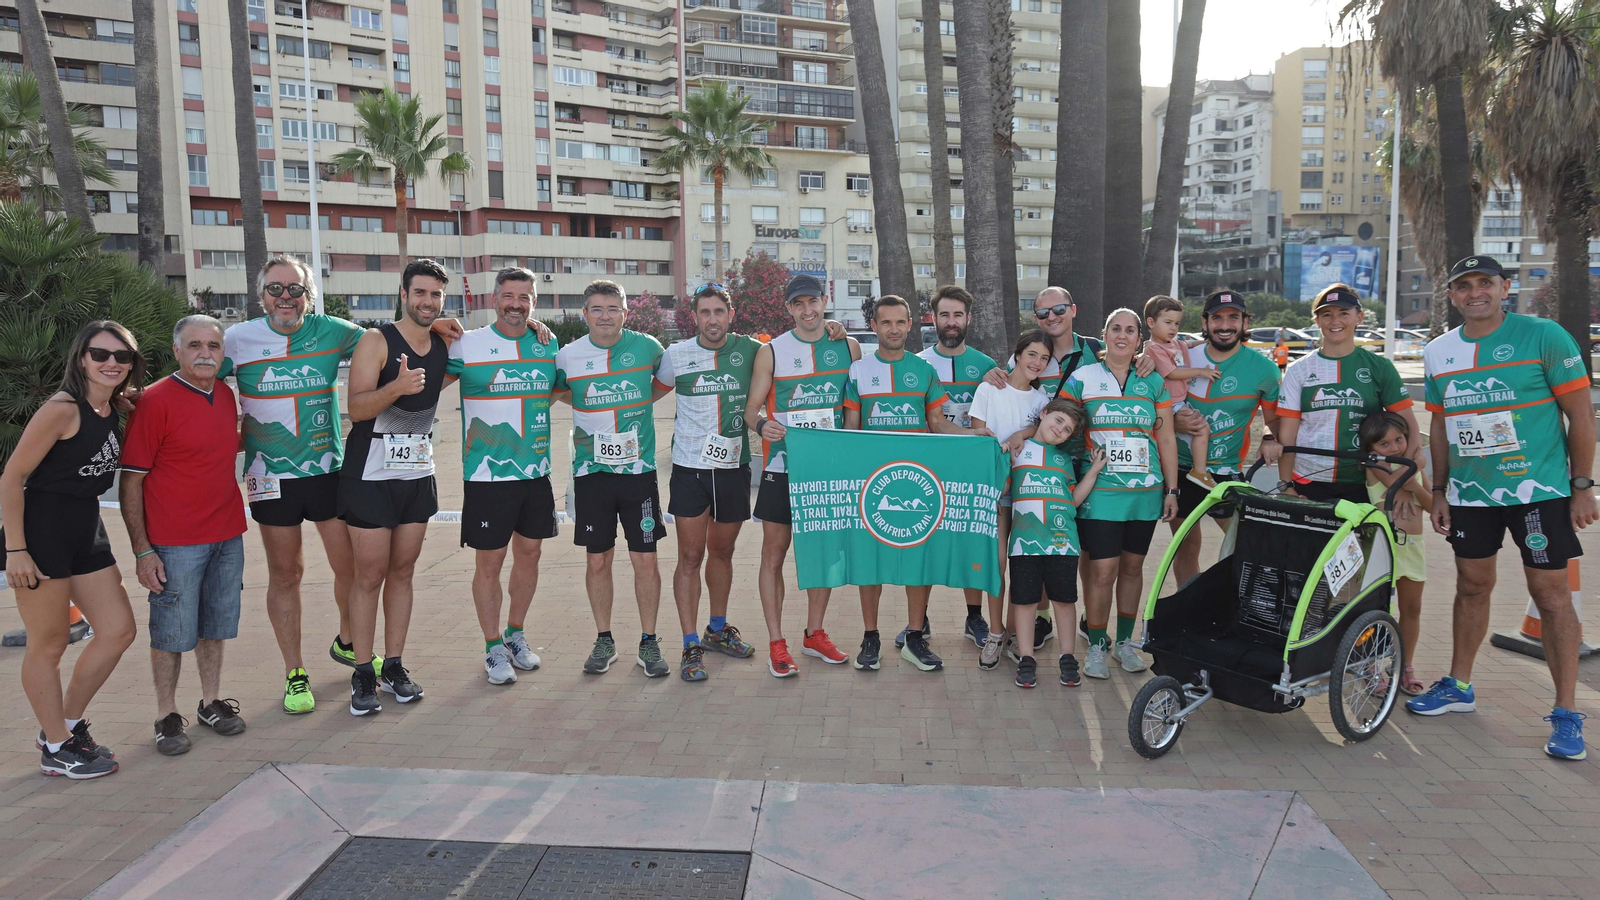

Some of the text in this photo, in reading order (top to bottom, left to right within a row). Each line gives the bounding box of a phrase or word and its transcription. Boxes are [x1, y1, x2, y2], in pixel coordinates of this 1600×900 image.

[755, 225, 821, 239] EuropaSur
[258, 376, 328, 392] EURAFRICA TRAIL
[490, 381, 550, 393] EURAFRICA TRAIL
[693, 382, 740, 394] EURAFRICA TRAIL
[305, 396, 332, 406] dinan
[584, 390, 642, 406] EURAFRICA TRAIL
[1311, 398, 1364, 409] EURAFRICA TRAIL
[1443, 390, 1517, 409] EURAFRICA TRAIL
[623, 408, 646, 418] dinan
[904, 416, 920, 425] TRAIL
[1092, 415, 1152, 426] EURAFRICA TRAIL
[1214, 418, 1235, 432] TRAIL
[1459, 430, 1484, 445] 624
[390, 446, 411, 460] 143
[600, 443, 622, 456] 863
[706, 444, 728, 460] 359
[1110, 450, 1132, 462] 546
[872, 469, 934, 496] CLUB DEPORTIVO
[1019, 486, 1065, 496] EURAFRICA TRAIL
[801, 492, 852, 507] EURAFRICA
[945, 494, 969, 507] TRAIL
[802, 507, 829, 519] TRAIL
[831, 505, 859, 518] TRAIL
[973, 509, 998, 526] TRAIL
[803, 518, 852, 533] EURAFRICA
[871, 511, 933, 538] EURAFRICA TRAIL
[1330, 560, 1346, 584] 381
